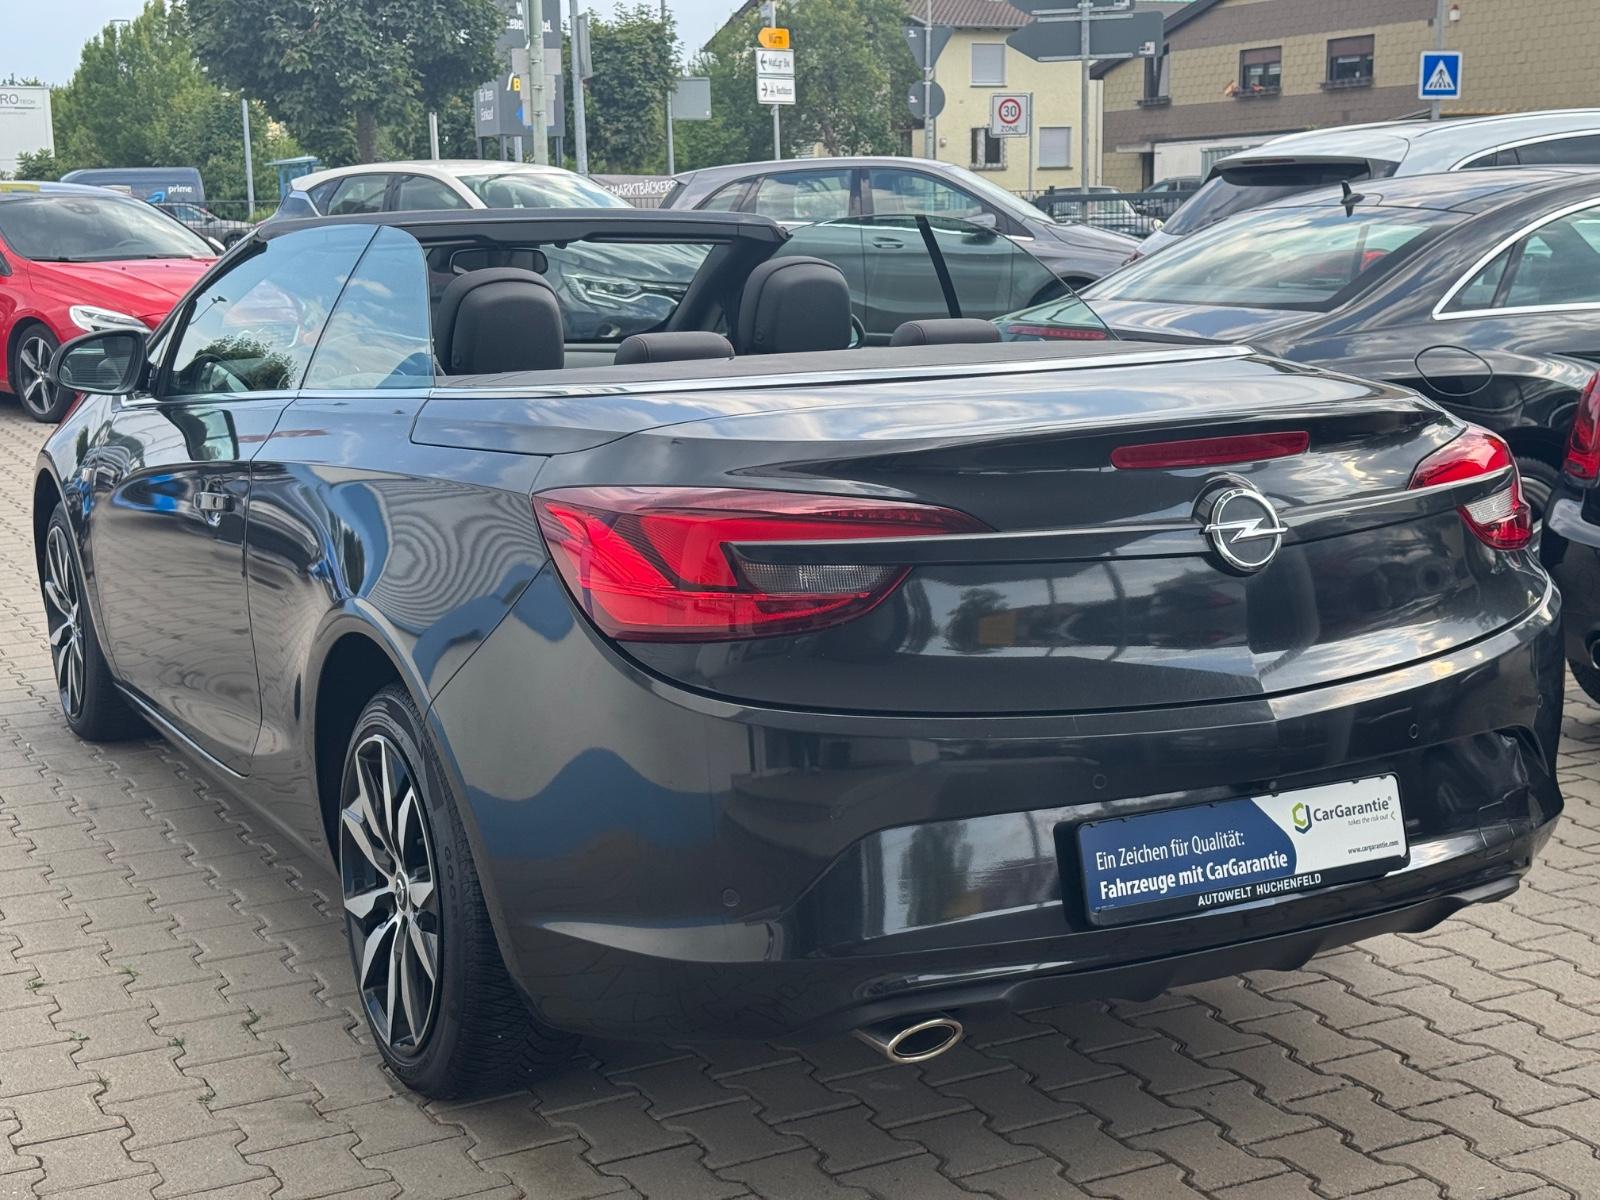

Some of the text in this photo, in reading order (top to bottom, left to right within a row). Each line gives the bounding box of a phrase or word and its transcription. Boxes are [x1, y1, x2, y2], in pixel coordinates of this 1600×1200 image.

[1003, 105, 1017, 117] 30
[168, 184, 193, 195] prime
[1370, 815, 1379, 823] risk
[1095, 830, 1246, 871] Ein Zeichen für Qualität:
[1347, 840, 1399, 854] www.cargarantie.com
[1099, 850, 1289, 900] Fahrzeuge mit CarGarantie
[1197, 873, 1322, 907] AUTOWELT HUCHENFELD
